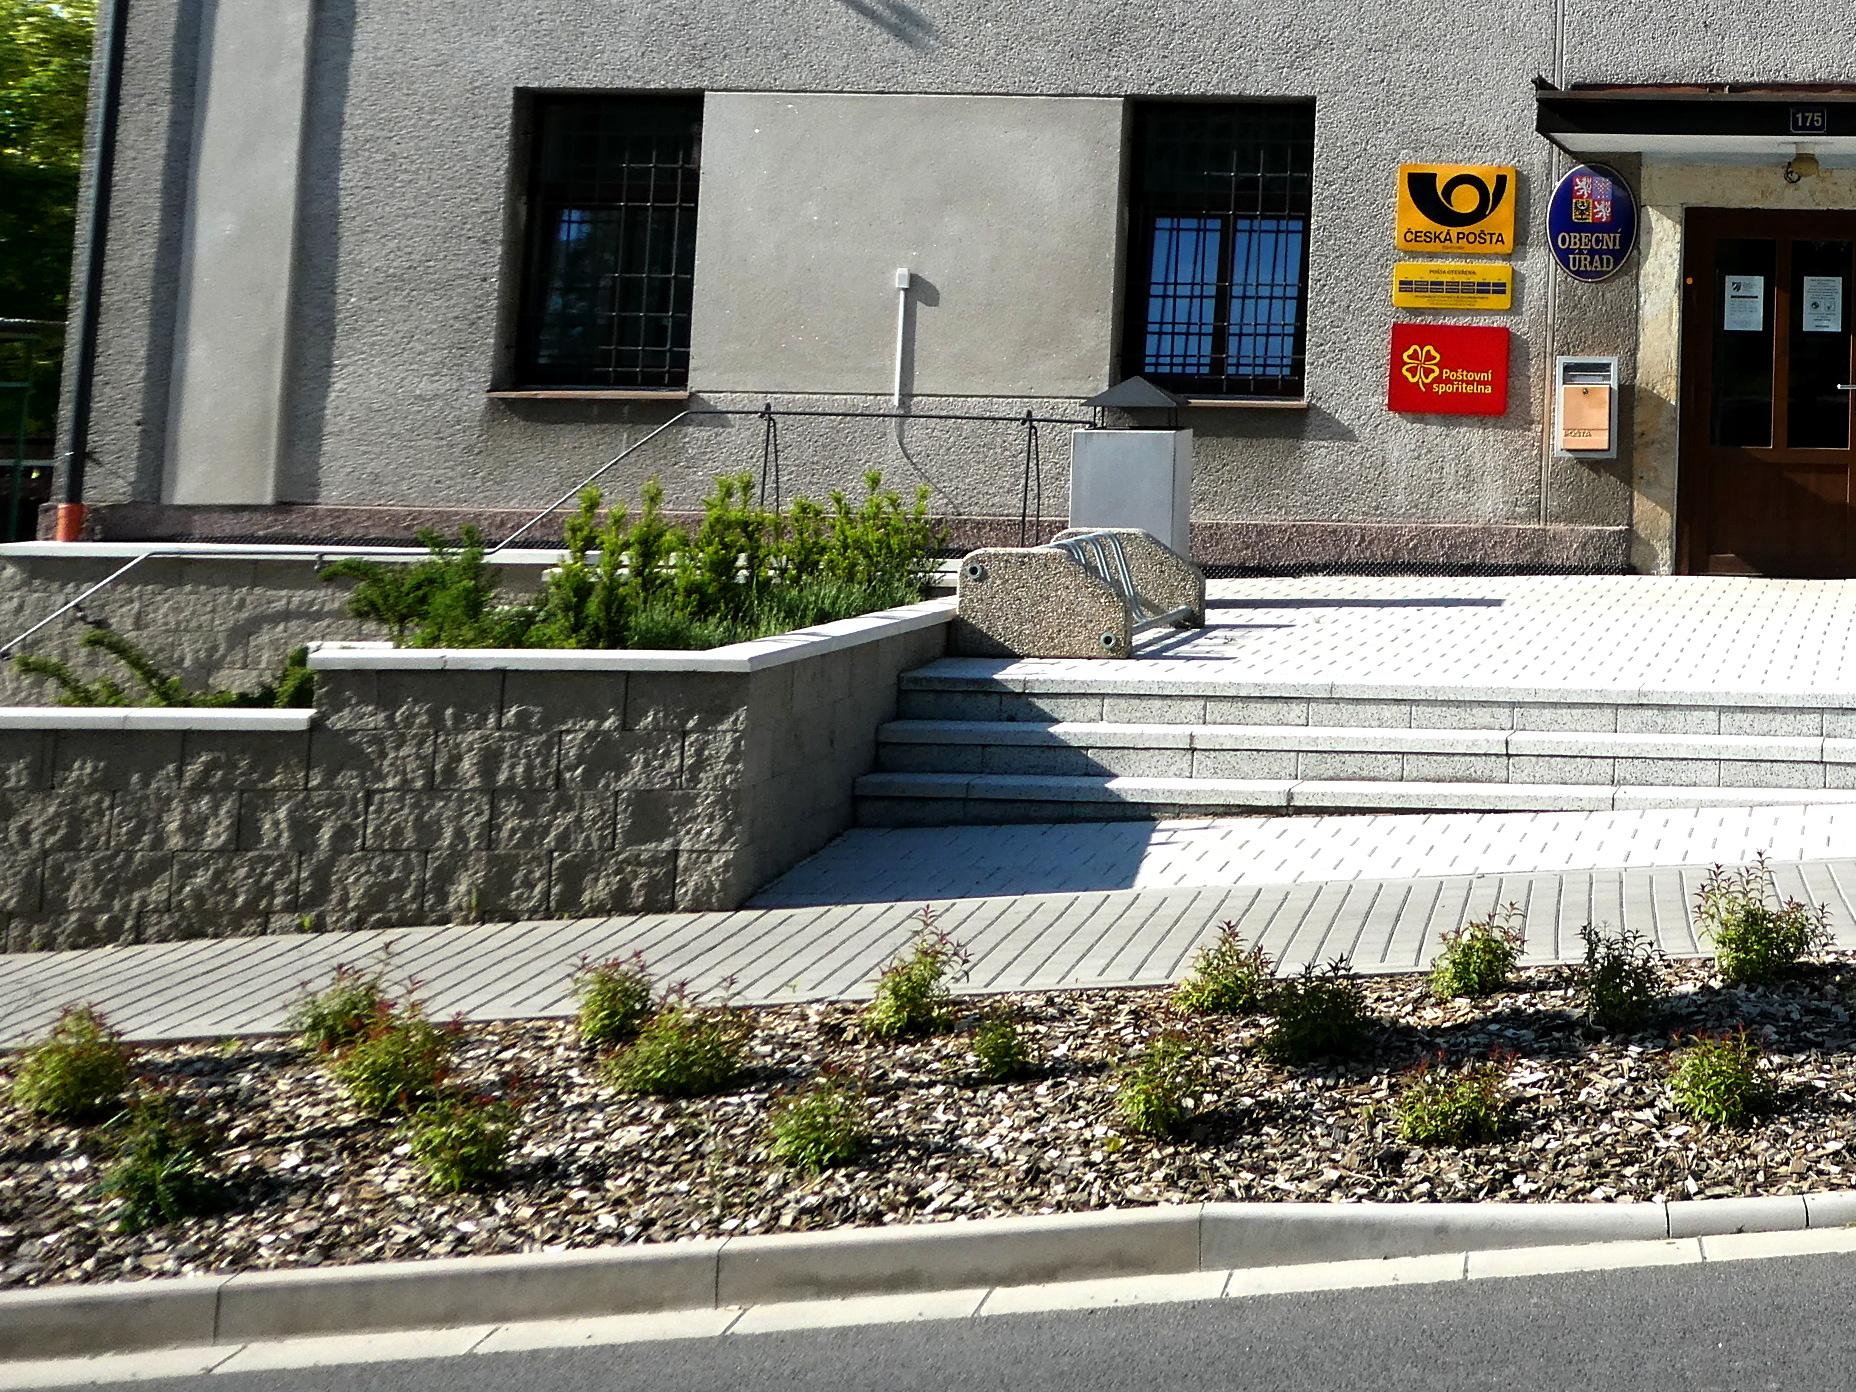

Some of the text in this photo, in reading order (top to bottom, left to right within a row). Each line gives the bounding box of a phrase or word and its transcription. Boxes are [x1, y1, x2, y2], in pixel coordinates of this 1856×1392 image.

[1796, 112, 1822, 127] 175
[1403, 228, 1505, 245] ČESKÁ POŠTA
[1557, 228, 1622, 249] OBECNÍ
[1568, 249, 1614, 271] ÚŘAD
[1442, 368, 1492, 381] Poštovní
[1432, 381, 1492, 395] spořitelna
